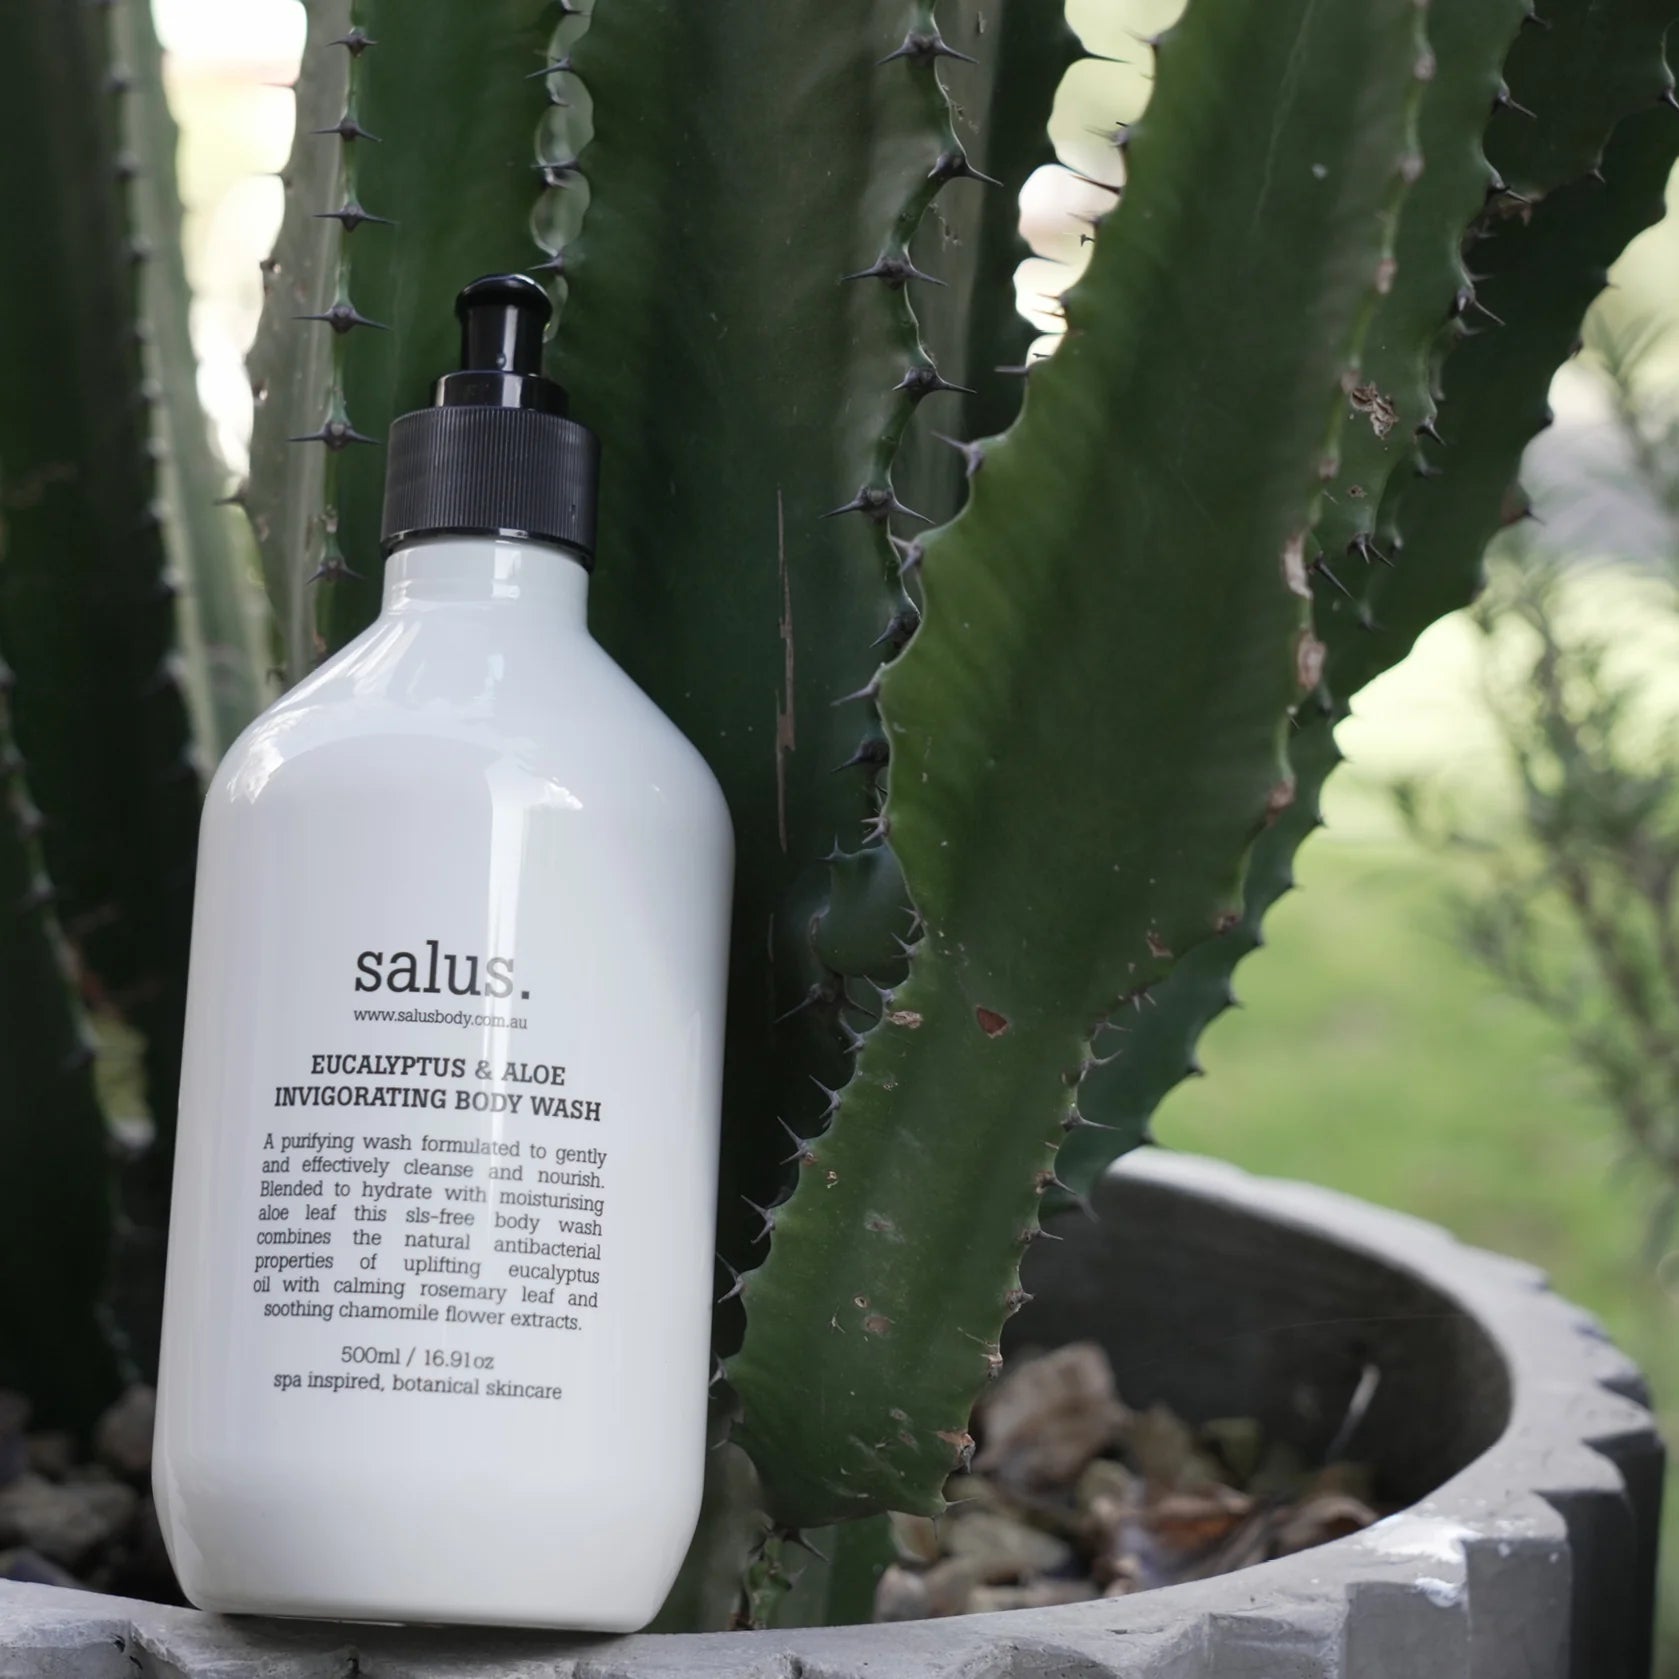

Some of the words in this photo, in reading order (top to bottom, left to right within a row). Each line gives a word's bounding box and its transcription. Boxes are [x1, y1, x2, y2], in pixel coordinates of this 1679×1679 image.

[354, 940, 530, 1000] salus.
[354, 1009, 527, 1029] www.salusbody.com.au
[311, 1054, 465, 1078] EUCALYPTUS
[475, 1060, 492, 1080] &
[501, 1062, 566, 1086] ALOE
[274, 1087, 446, 1109] INVIGORATING
[455, 1091, 523, 1113] BODY
[530, 1096, 601, 1121] WASH
[263, 1134, 274, 1150] A
[281, 1133, 354, 1153] purifying
[363, 1134, 411, 1151] wash
[421, 1135, 520, 1157] formulated
[530, 1144, 546, 1159] to
[556, 1147, 607, 1168] gently
[262, 1157, 289, 1173] and
[302, 1157, 389, 1177] effectively
[404, 1159, 473, 1178] cleanse
[488, 1165, 523, 1181] and
[538, 1169, 604, 1189] nourish.
[260, 1181, 323, 1197] Blended
[334, 1182, 350, 1197] to
[362, 1182, 432, 1203] hydrate
[445, 1186, 487, 1202] with
[499, 1191, 604, 1216] moisturising
[258, 1206, 288, 1221] aloe
[306, 1205, 337, 1221] leaf
[354, 1206, 386, 1222] this
[406, 1207, 474, 1226] sls-free
[494, 1212, 540, 1233] body
[558, 1218, 602, 1236] wash
[257, 1229, 331, 1245] combines
[353, 1230, 381, 1246] the
[404, 1232, 470, 1250] natural
[494, 1237, 601, 1260] antibacterial
[255, 1253, 333, 1272] properties
[360, 1253, 377, 1270] of
[404, 1257, 481, 1279] uplifting
[508, 1262, 600, 1285] eucalyptus
[253, 1277, 271, 1293] oil
[282, 1277, 319, 1292] with
[333, 1278, 405, 1299] calming
[420, 1283, 507, 1305] rosemary
[522, 1287, 554, 1304] leaf
[568, 1291, 598, 1308] and
[264, 1301, 333, 1322] soothing
[339, 1303, 438, 1322] chamomile
[446, 1306, 505, 1325] flower
[510, 1311, 582, 1331] extracts.
[341, 1346, 400, 1364] 500ml
[406, 1347, 415, 1367] /
[273, 1372, 302, 1392] spa
[308, 1372, 384, 1393] inspired,
[392, 1374, 479, 1395] botanical
[486, 1381, 562, 1400] skincare
